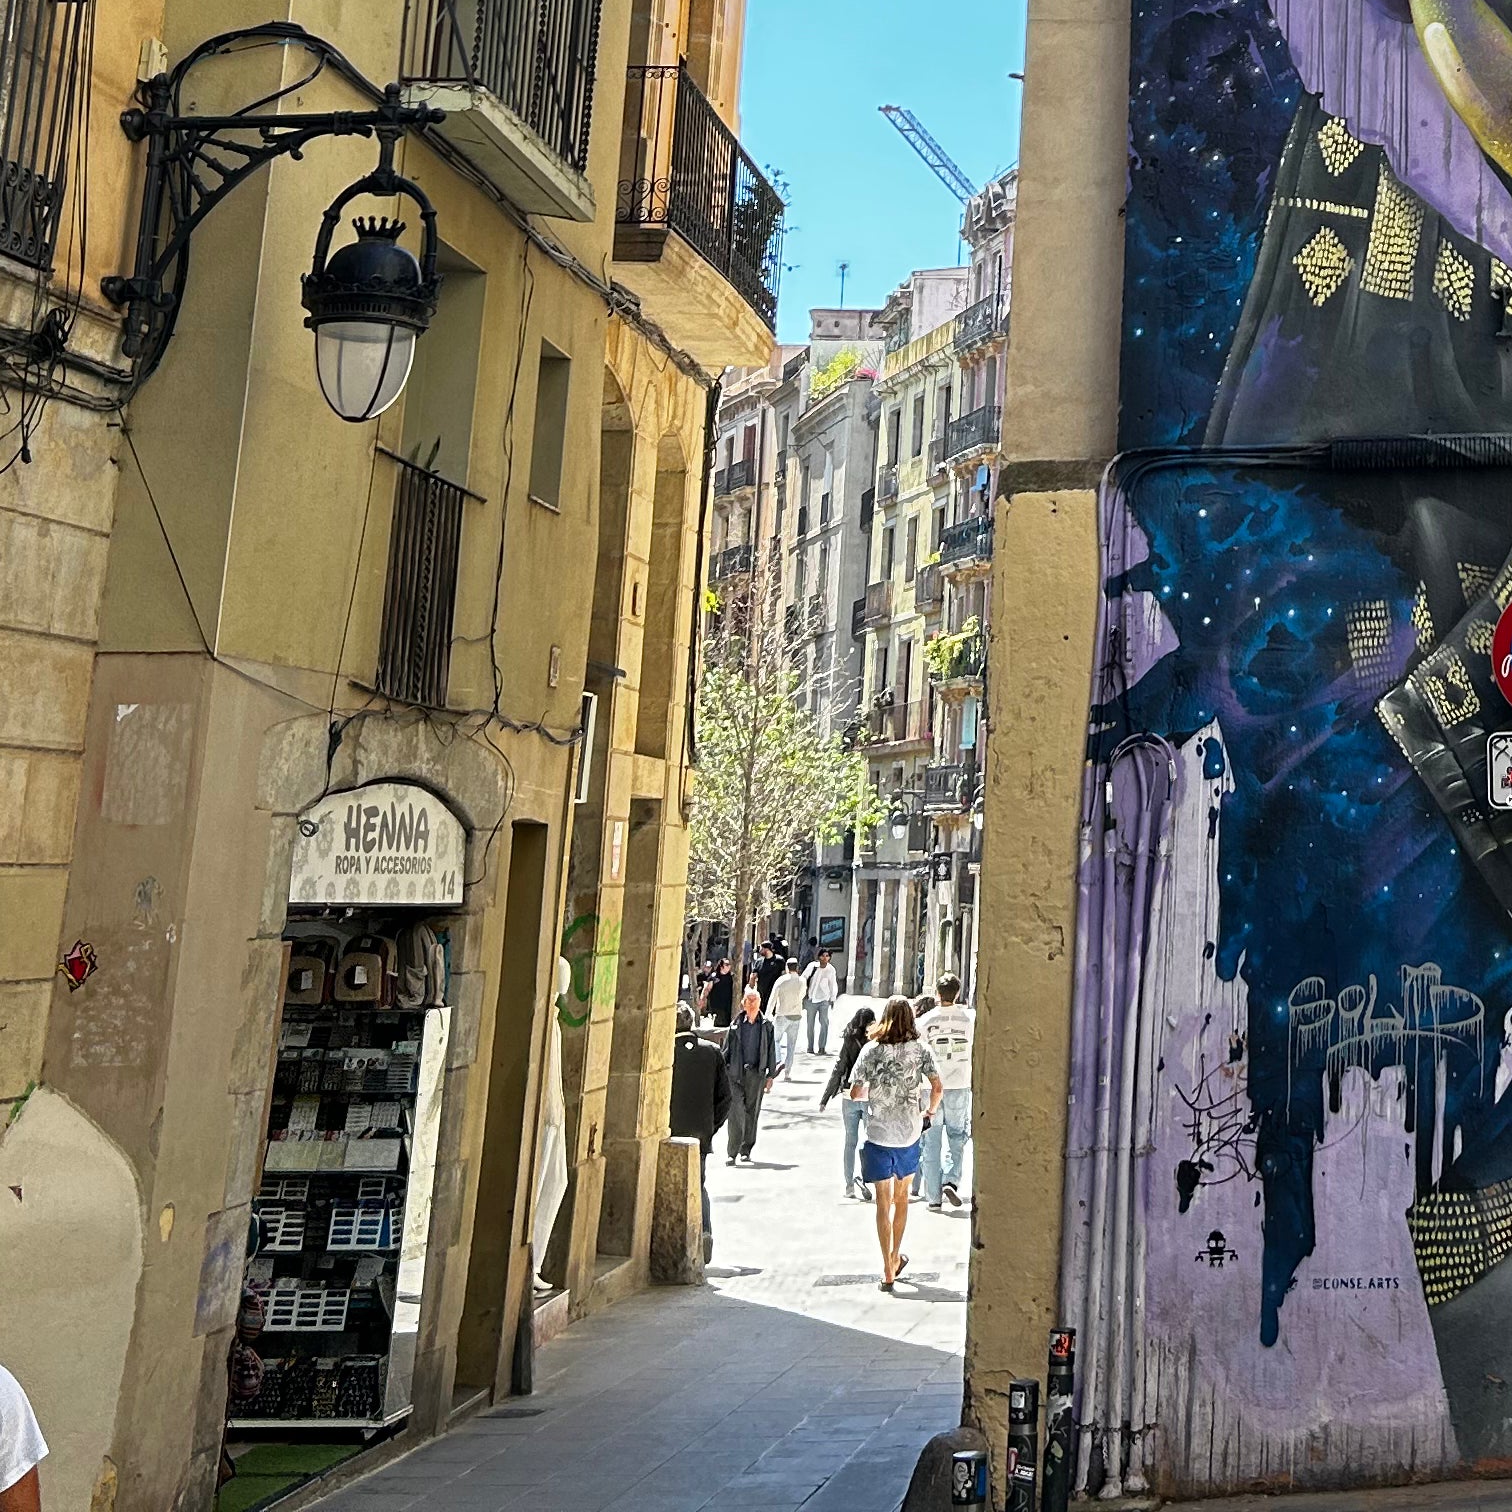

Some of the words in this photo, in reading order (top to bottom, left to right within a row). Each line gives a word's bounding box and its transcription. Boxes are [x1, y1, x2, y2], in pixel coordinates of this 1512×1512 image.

[343, 801, 430, 854] HENNA
[335, 855, 362, 874] ROPA
[365, 855, 373, 874] Y
[373, 856, 433, 874] ACCESORIOS
[440, 870, 456, 901] 14
